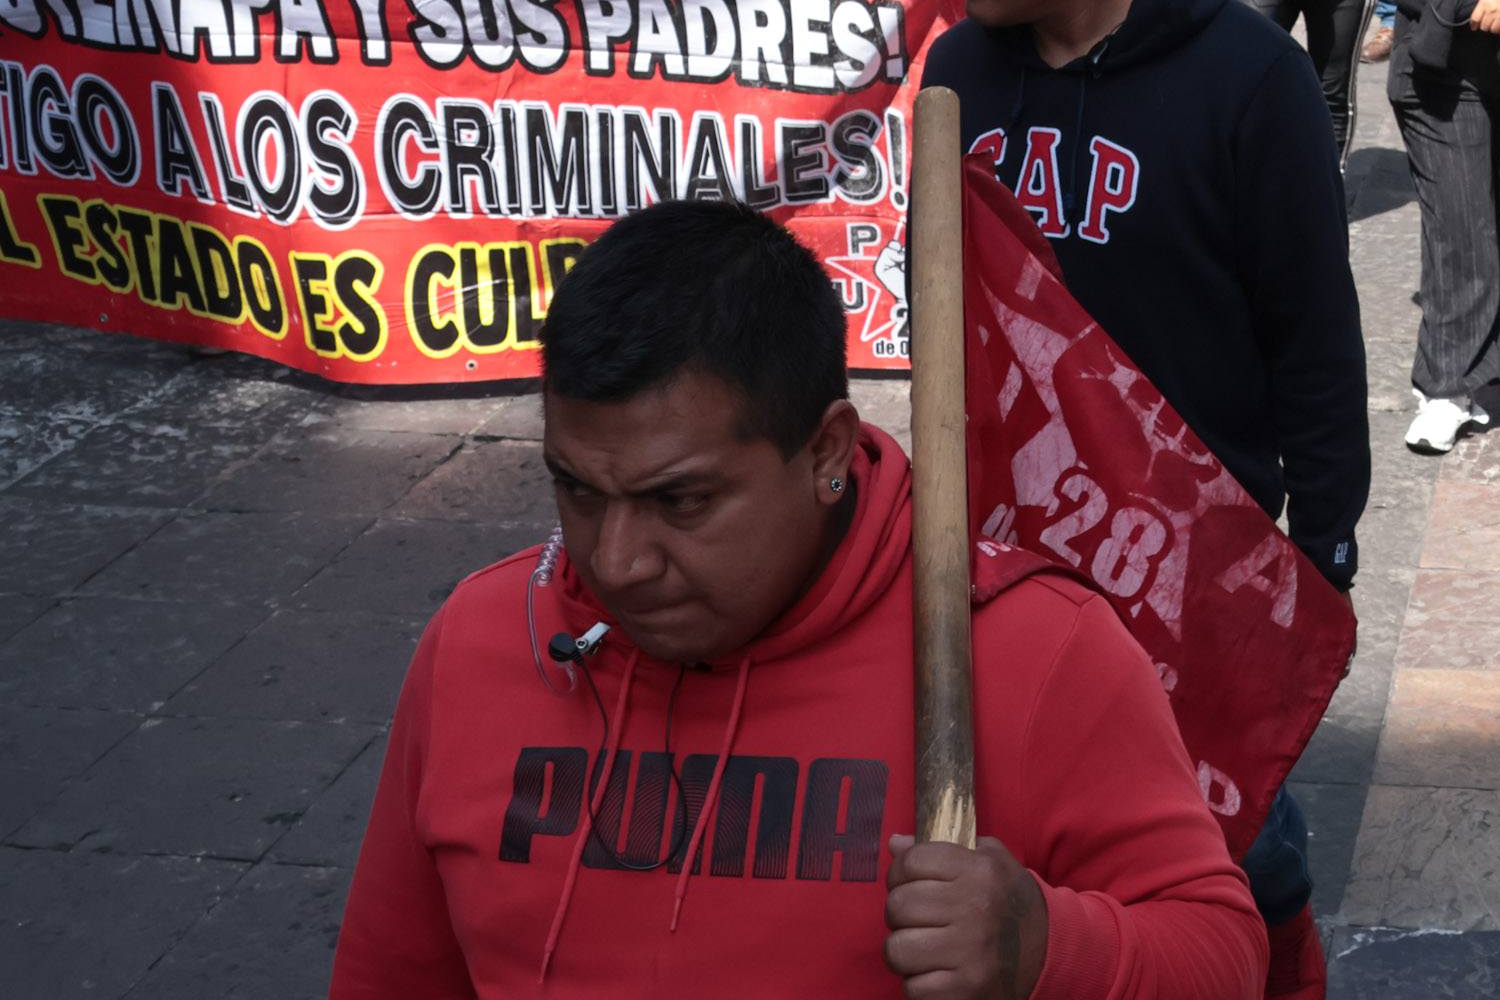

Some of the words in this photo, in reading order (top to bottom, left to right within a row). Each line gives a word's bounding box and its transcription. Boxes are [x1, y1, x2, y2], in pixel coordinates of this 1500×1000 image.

[0, 60, 141, 187] IGO
[152, 82, 216, 205] A
[200, 90, 365, 230] LOS
[376, 94, 907, 221] CRIMINALES!
[37, 194, 288, 340] ESTADO
[289, 250, 388, 362] ES
[846, 222, 881, 256] P
[874, 338, 896, 356] de
[1039, 467, 1168, 598] 28
[499, 746, 889, 882] PUMA
